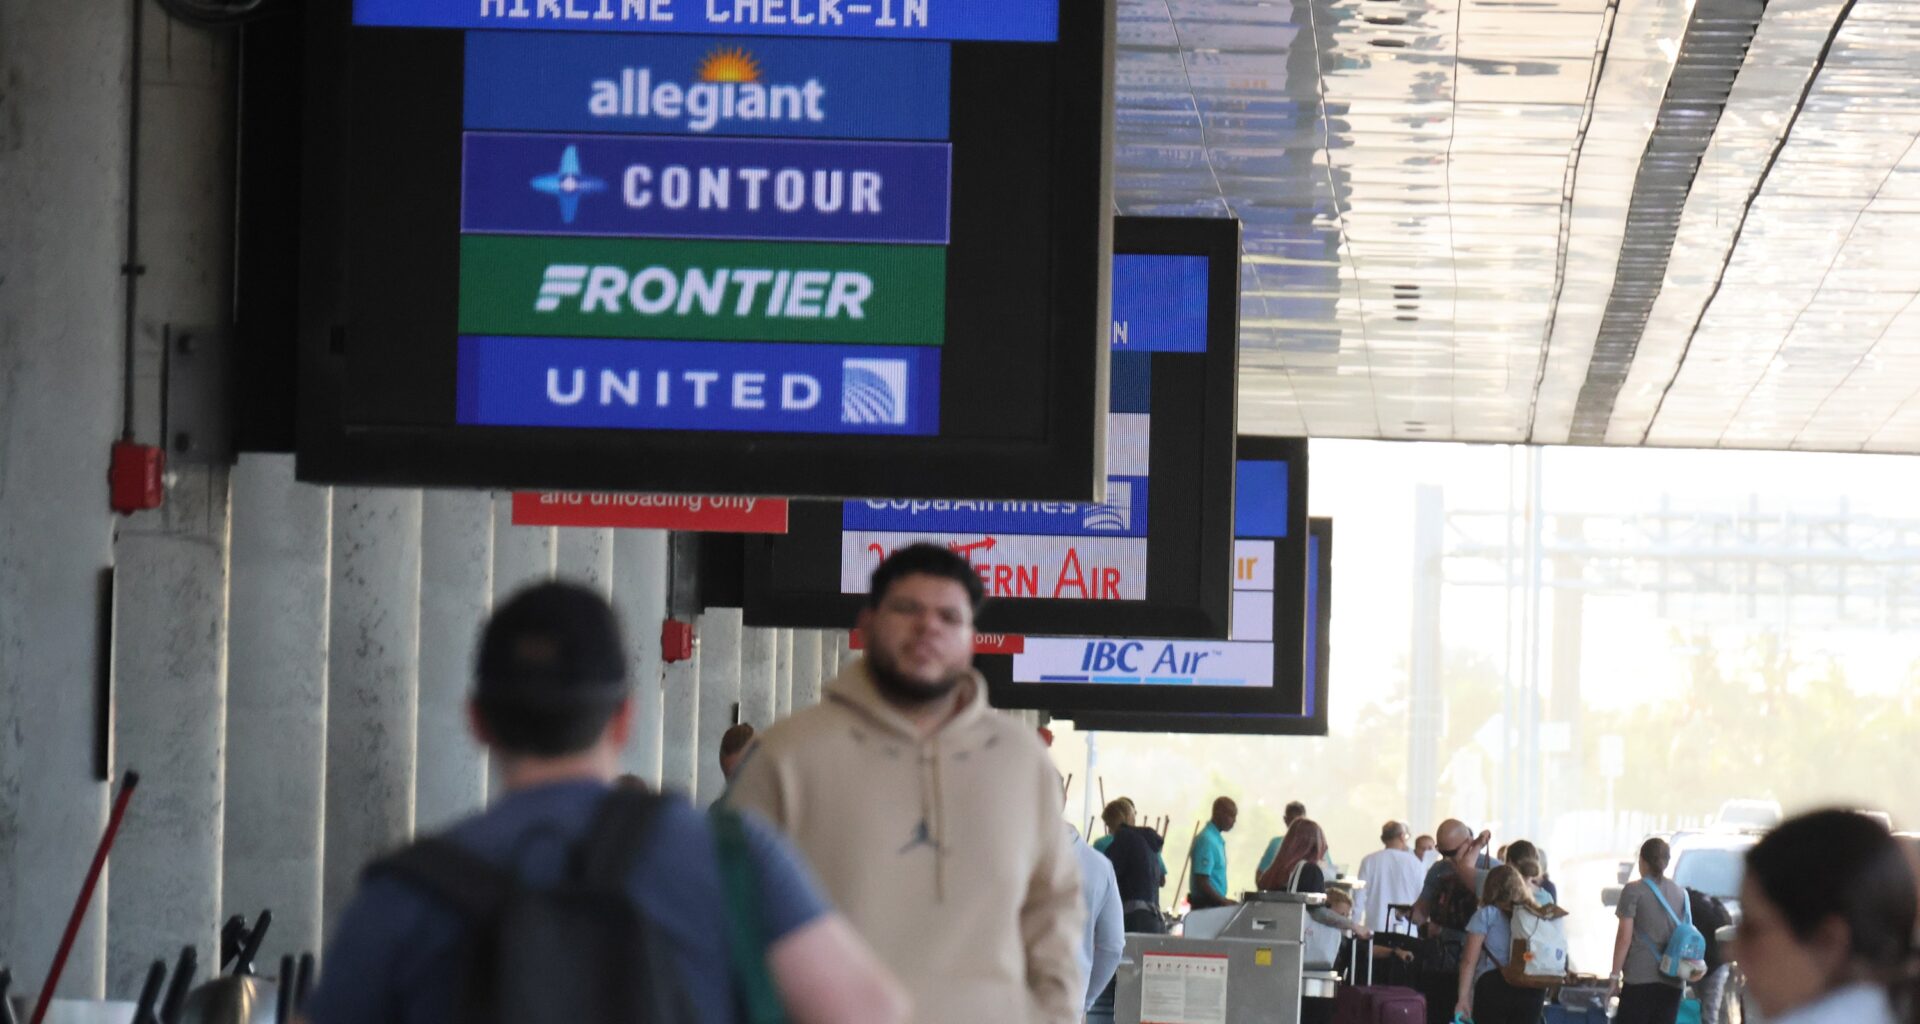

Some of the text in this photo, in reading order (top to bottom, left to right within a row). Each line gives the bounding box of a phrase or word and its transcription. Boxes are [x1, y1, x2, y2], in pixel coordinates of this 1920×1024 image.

[706, 0, 928, 27] CHECK-IN
[588, 68, 825, 131] allegiant
[623, 165, 883, 213] CONTOUR
[535, 264, 873, 319] FRONTIER
[546, 367, 822, 411] UNITED
[1081, 642, 1143, 673] IBC
[1151, 643, 1209, 674] Air
